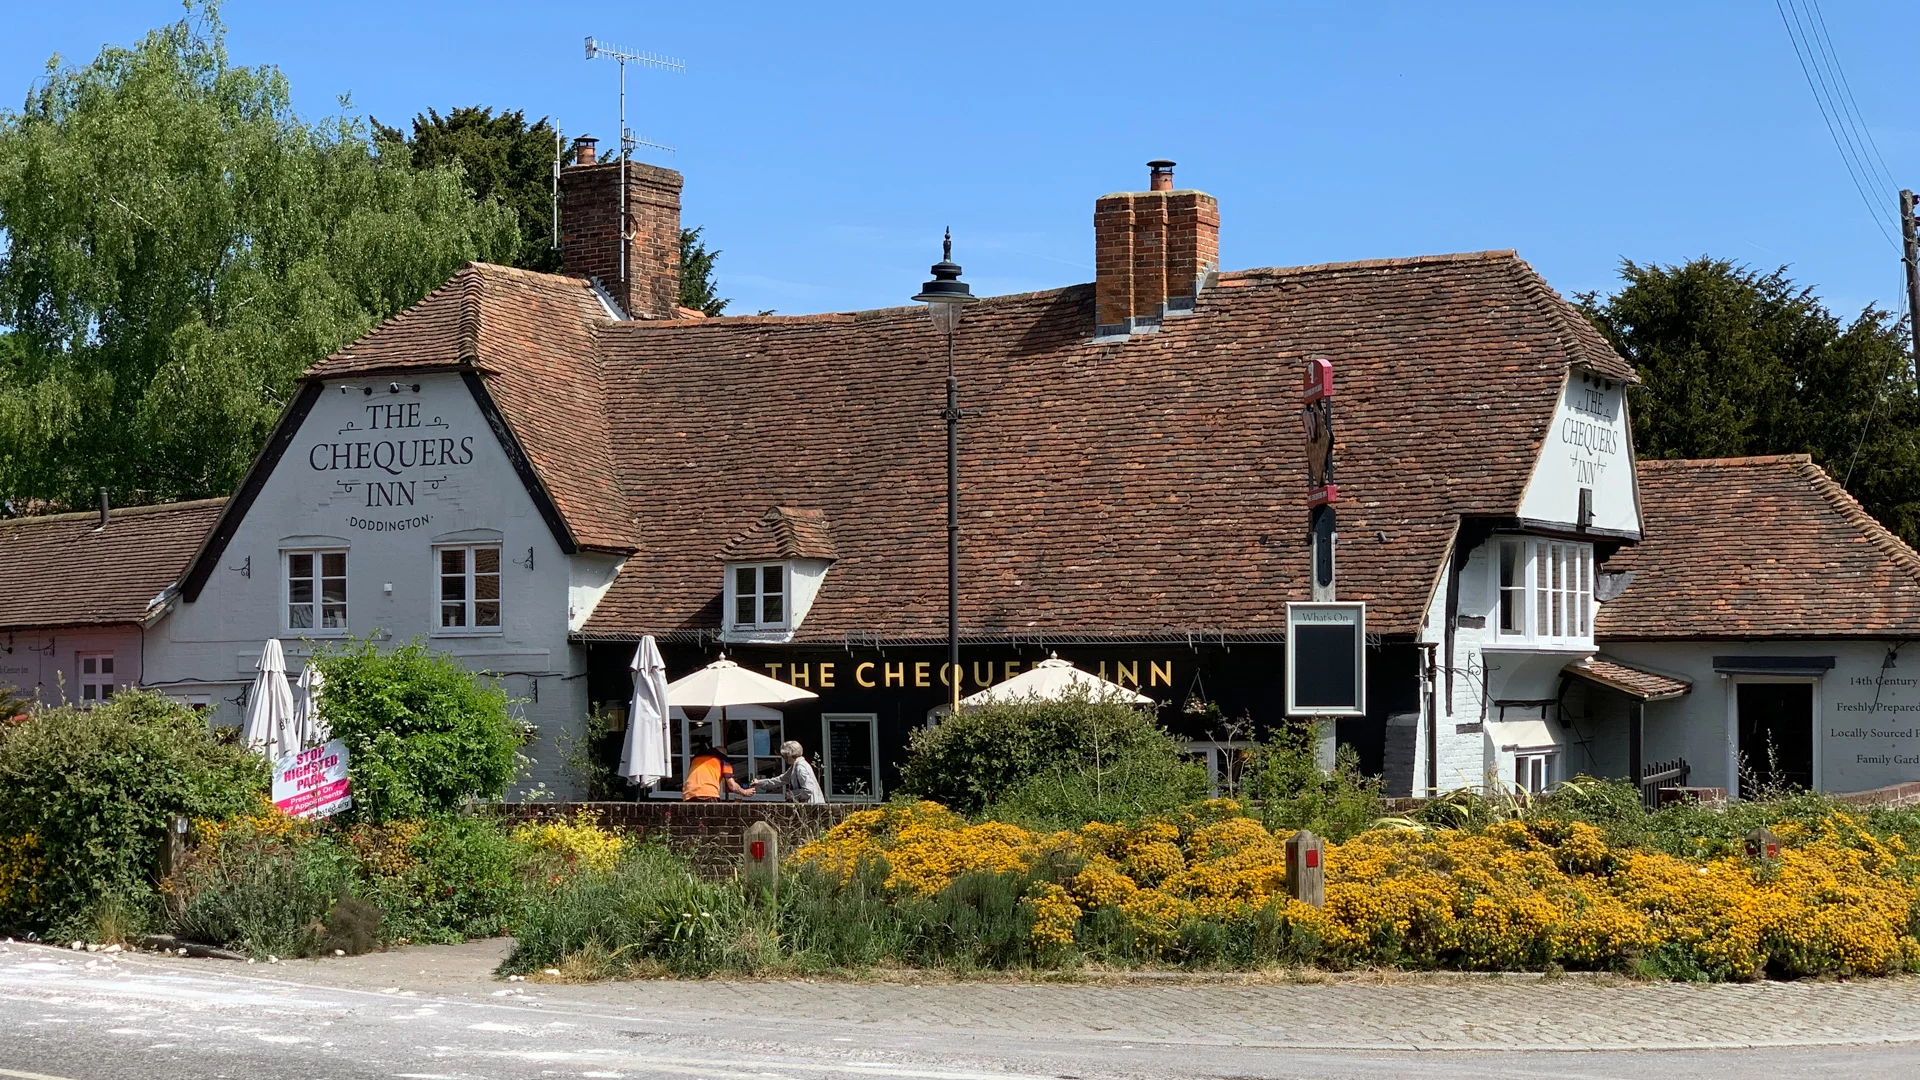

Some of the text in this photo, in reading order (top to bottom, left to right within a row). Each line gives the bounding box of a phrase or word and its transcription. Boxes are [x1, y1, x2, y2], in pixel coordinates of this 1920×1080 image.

[1585, 388, 1604, 416] THE
[365, 402, 421, 430] THE
[1562, 417, 1618, 456] CHEQUERS
[309, 436, 473, 475] CHEQUERS
[1577, 460, 1597, 485] INN
[365, 481, 417, 507] INN
[349, 514, 430, 532] DODDINGTON
[1302, 612, 1349, 622] What's On
[765, 660, 1172, 692] THE CHEQUE INN
[1850, 676, 1918, 688] 14th Century
[1837, 702, 1920, 714] Freshly Prepared
[1831, 728, 1868, 740] Locally
[1870, 728, 1912, 738] Sourced
[296, 746, 325, 766] STOP
[1856, 754, 1891, 766] Family
[283, 754, 338, 783] HIGHSTED
[296, 772, 326, 791] PARK
